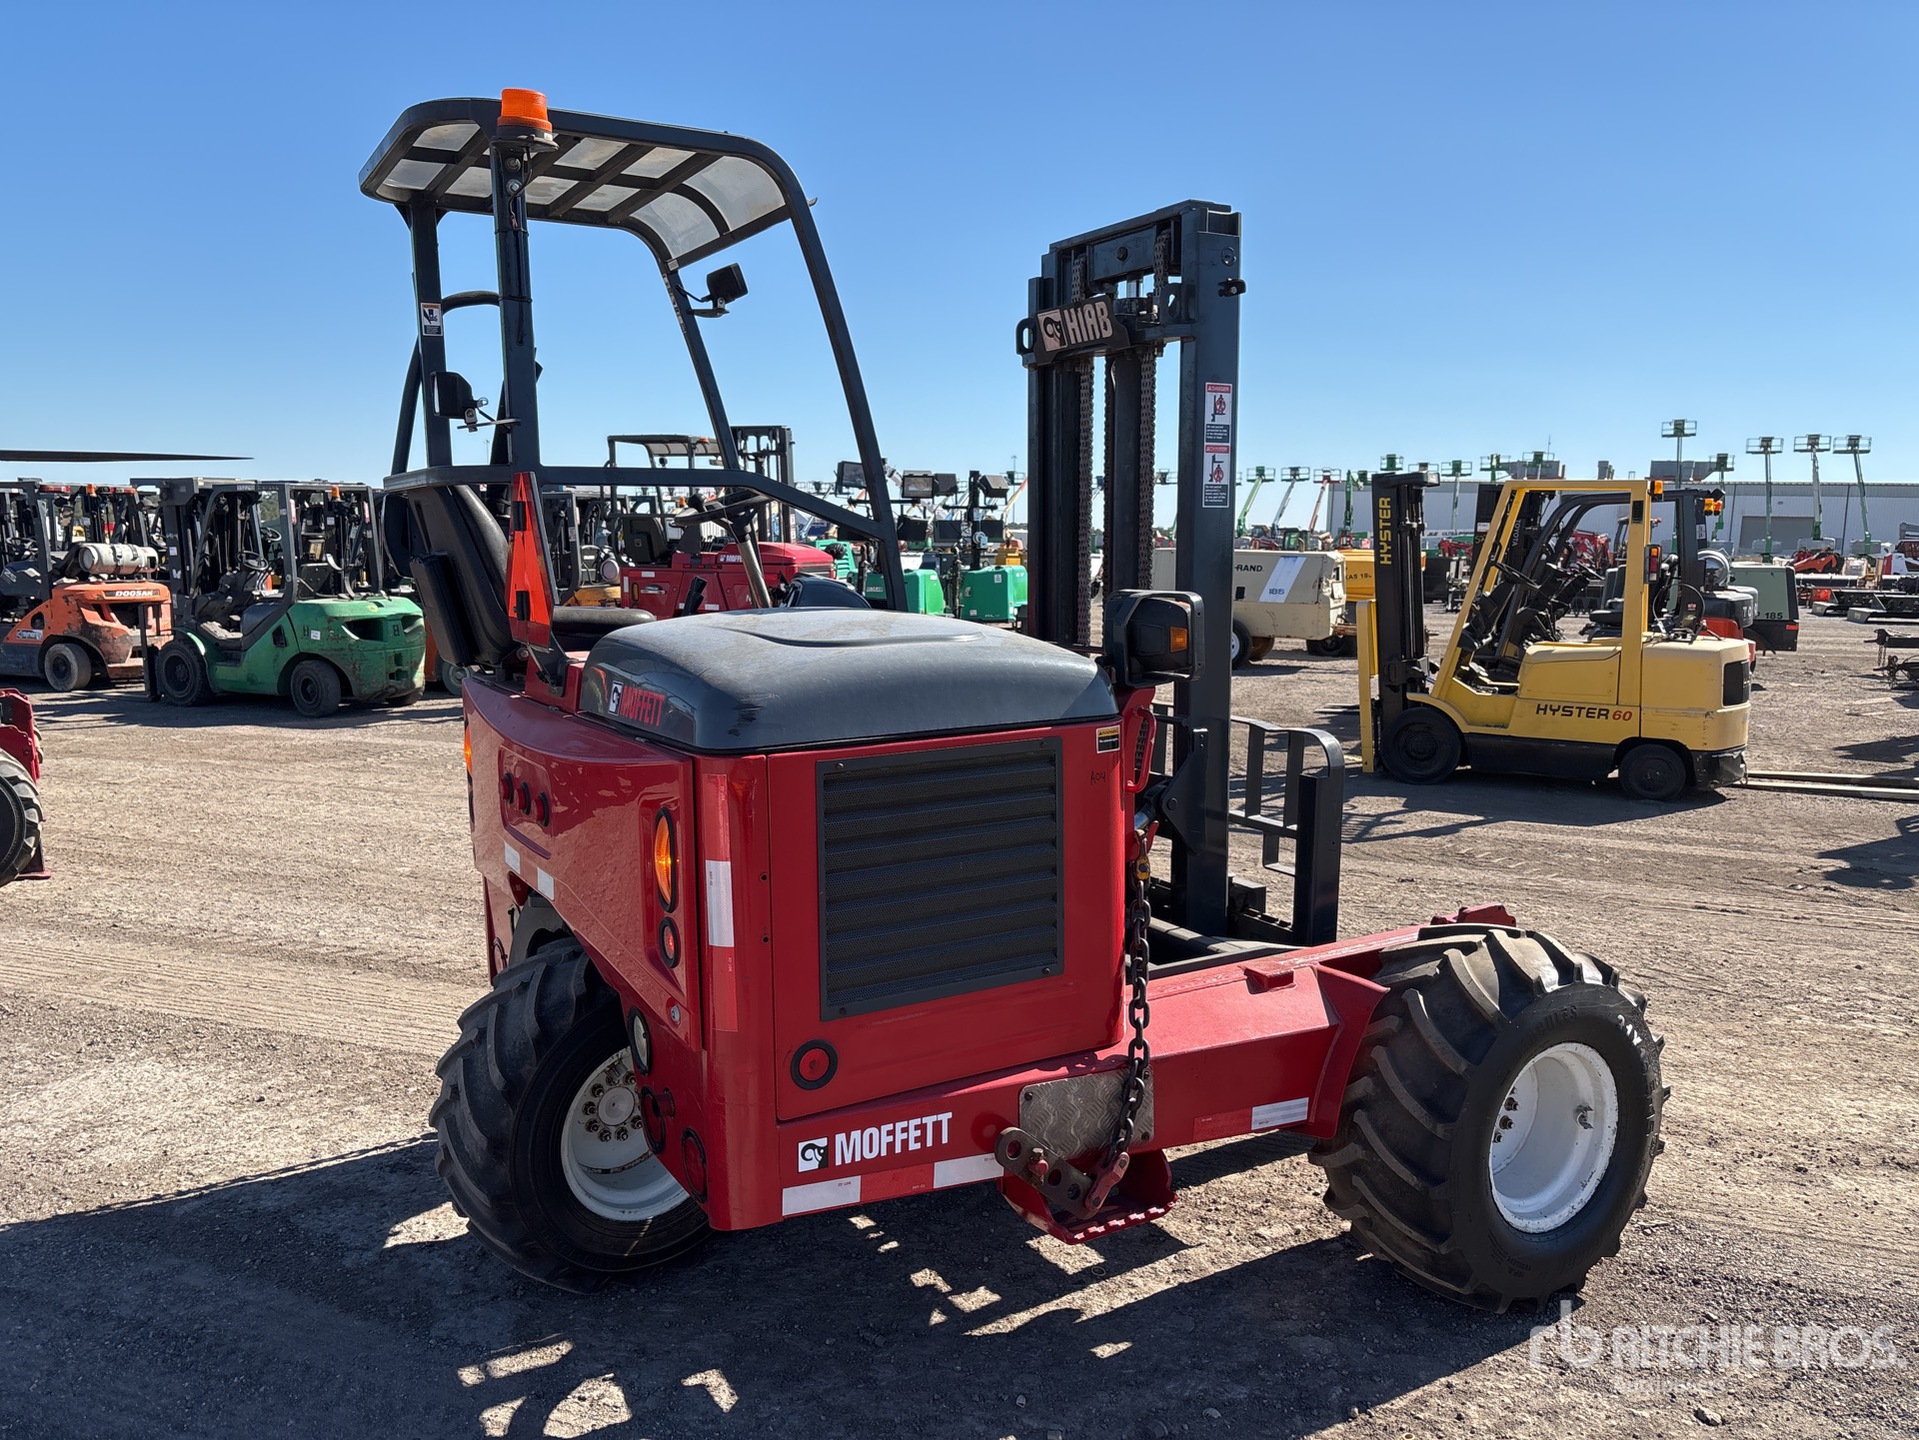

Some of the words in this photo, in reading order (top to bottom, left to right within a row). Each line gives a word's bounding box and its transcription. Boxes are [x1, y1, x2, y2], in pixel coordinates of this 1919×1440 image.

[1064, 301, 1113, 344] HIAB
[1379, 497, 1392, 565] HYSTER
[1512, 519, 1522, 547] TOYOTA
[726, 554, 743, 562] MOFFE
[1765, 611, 1783, 619] 185
[620, 685, 666, 727] MOFFETT
[1536, 704, 1610, 720] HYSTER
[1612, 710, 1633, 721] 60
[834, 1111, 953, 1167] MOFFETT
